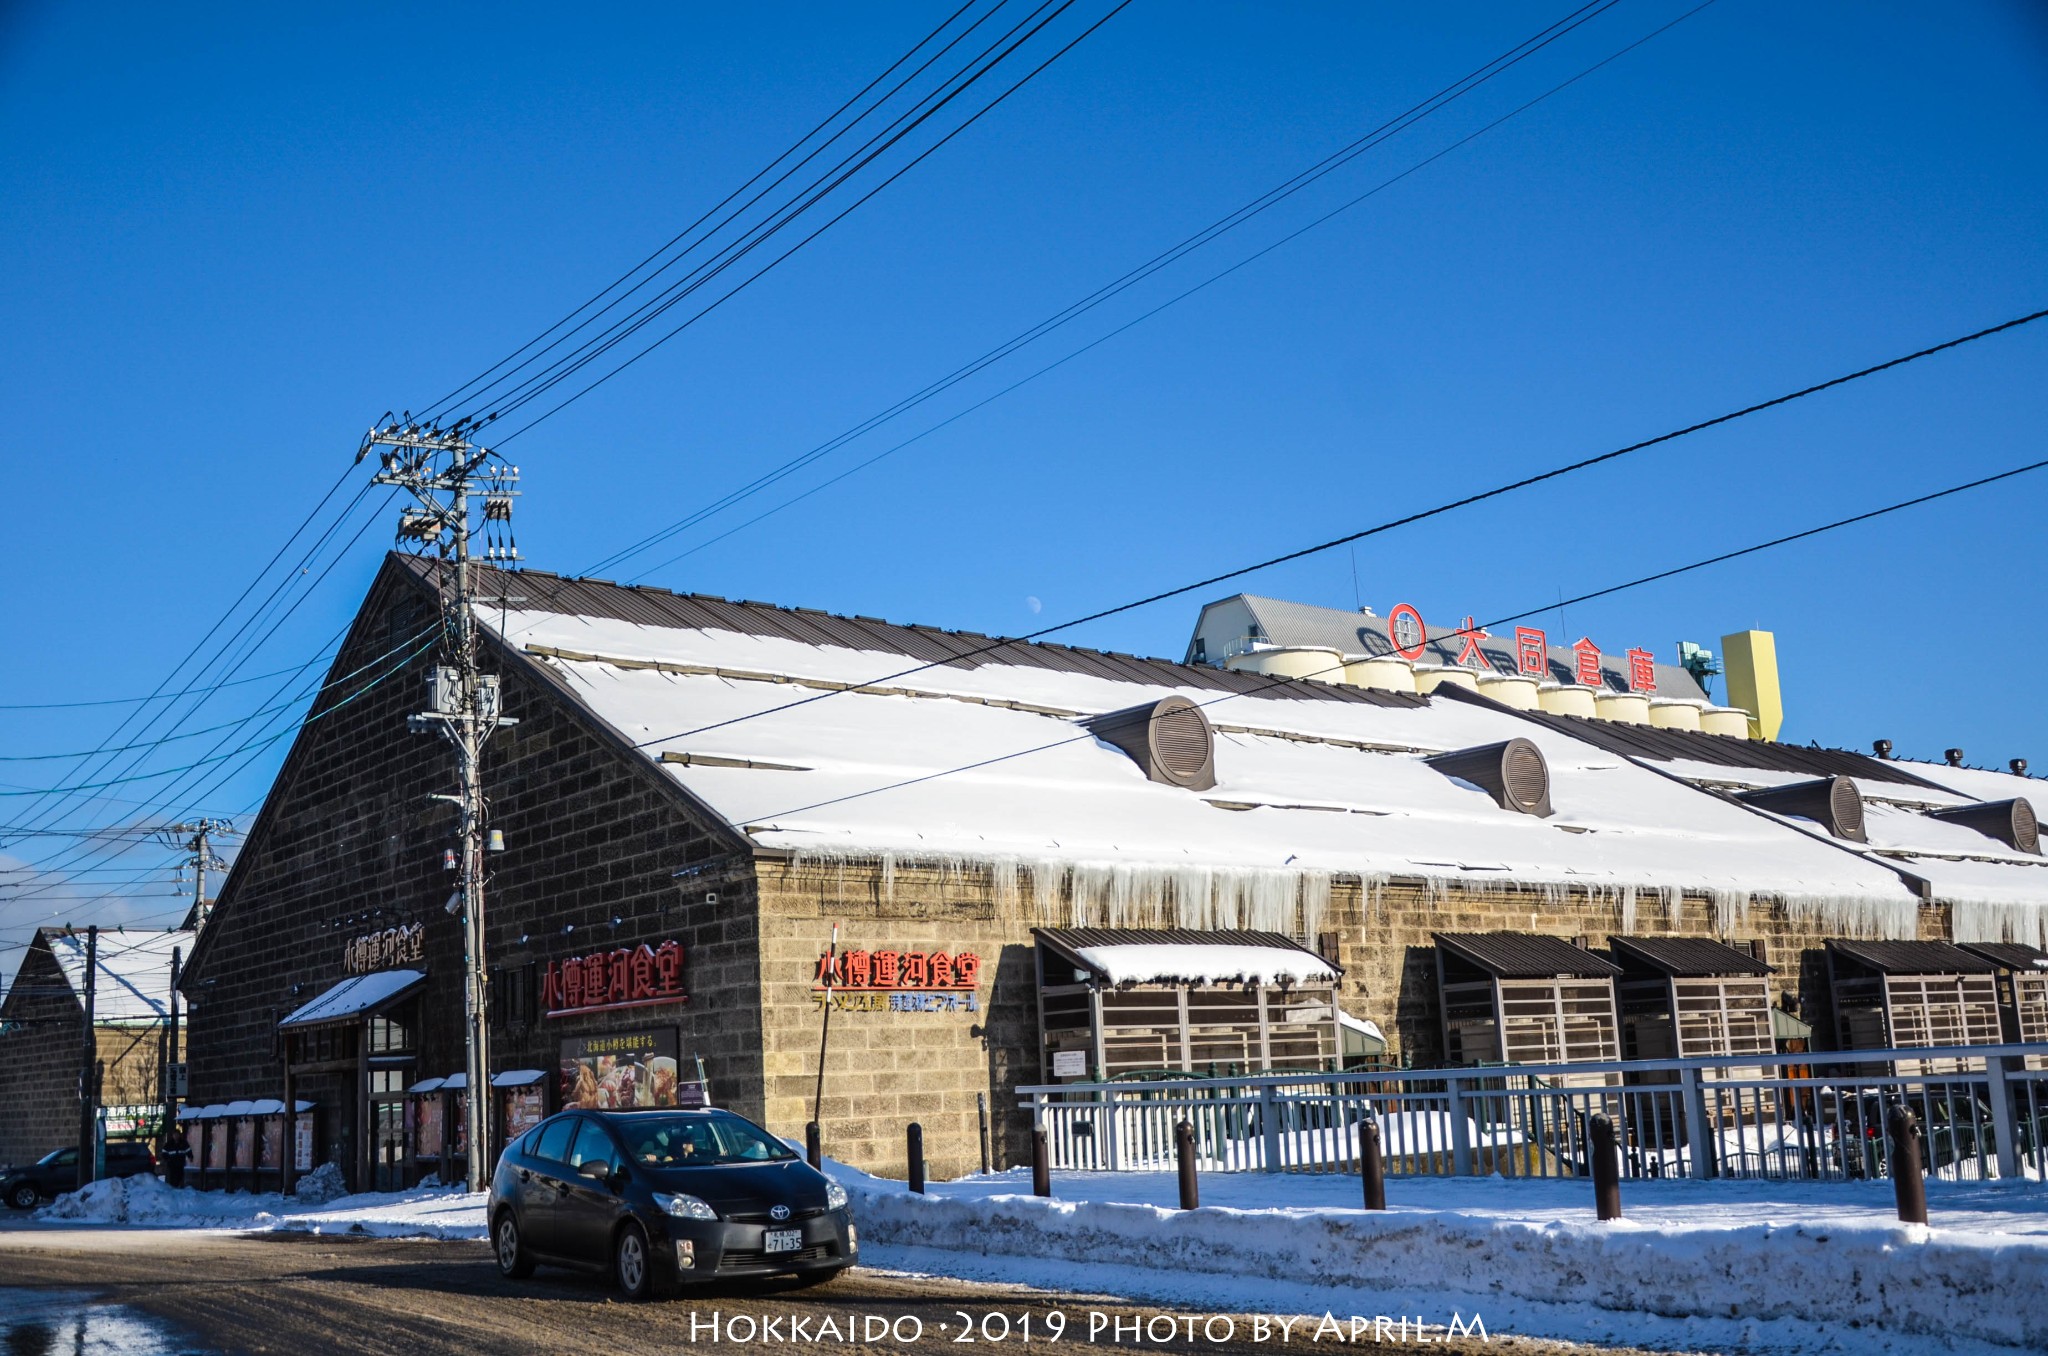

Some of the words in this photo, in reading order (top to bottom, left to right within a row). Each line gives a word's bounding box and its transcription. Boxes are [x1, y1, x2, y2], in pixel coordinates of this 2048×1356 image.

[1455, 615, 1657, 692] 大同倉庫
[541, 939, 685, 1011] 小樽運河食堂
[817, 950, 981, 986] 小樽運河食堂
[773, 1237, 801, 1250] 71-35
